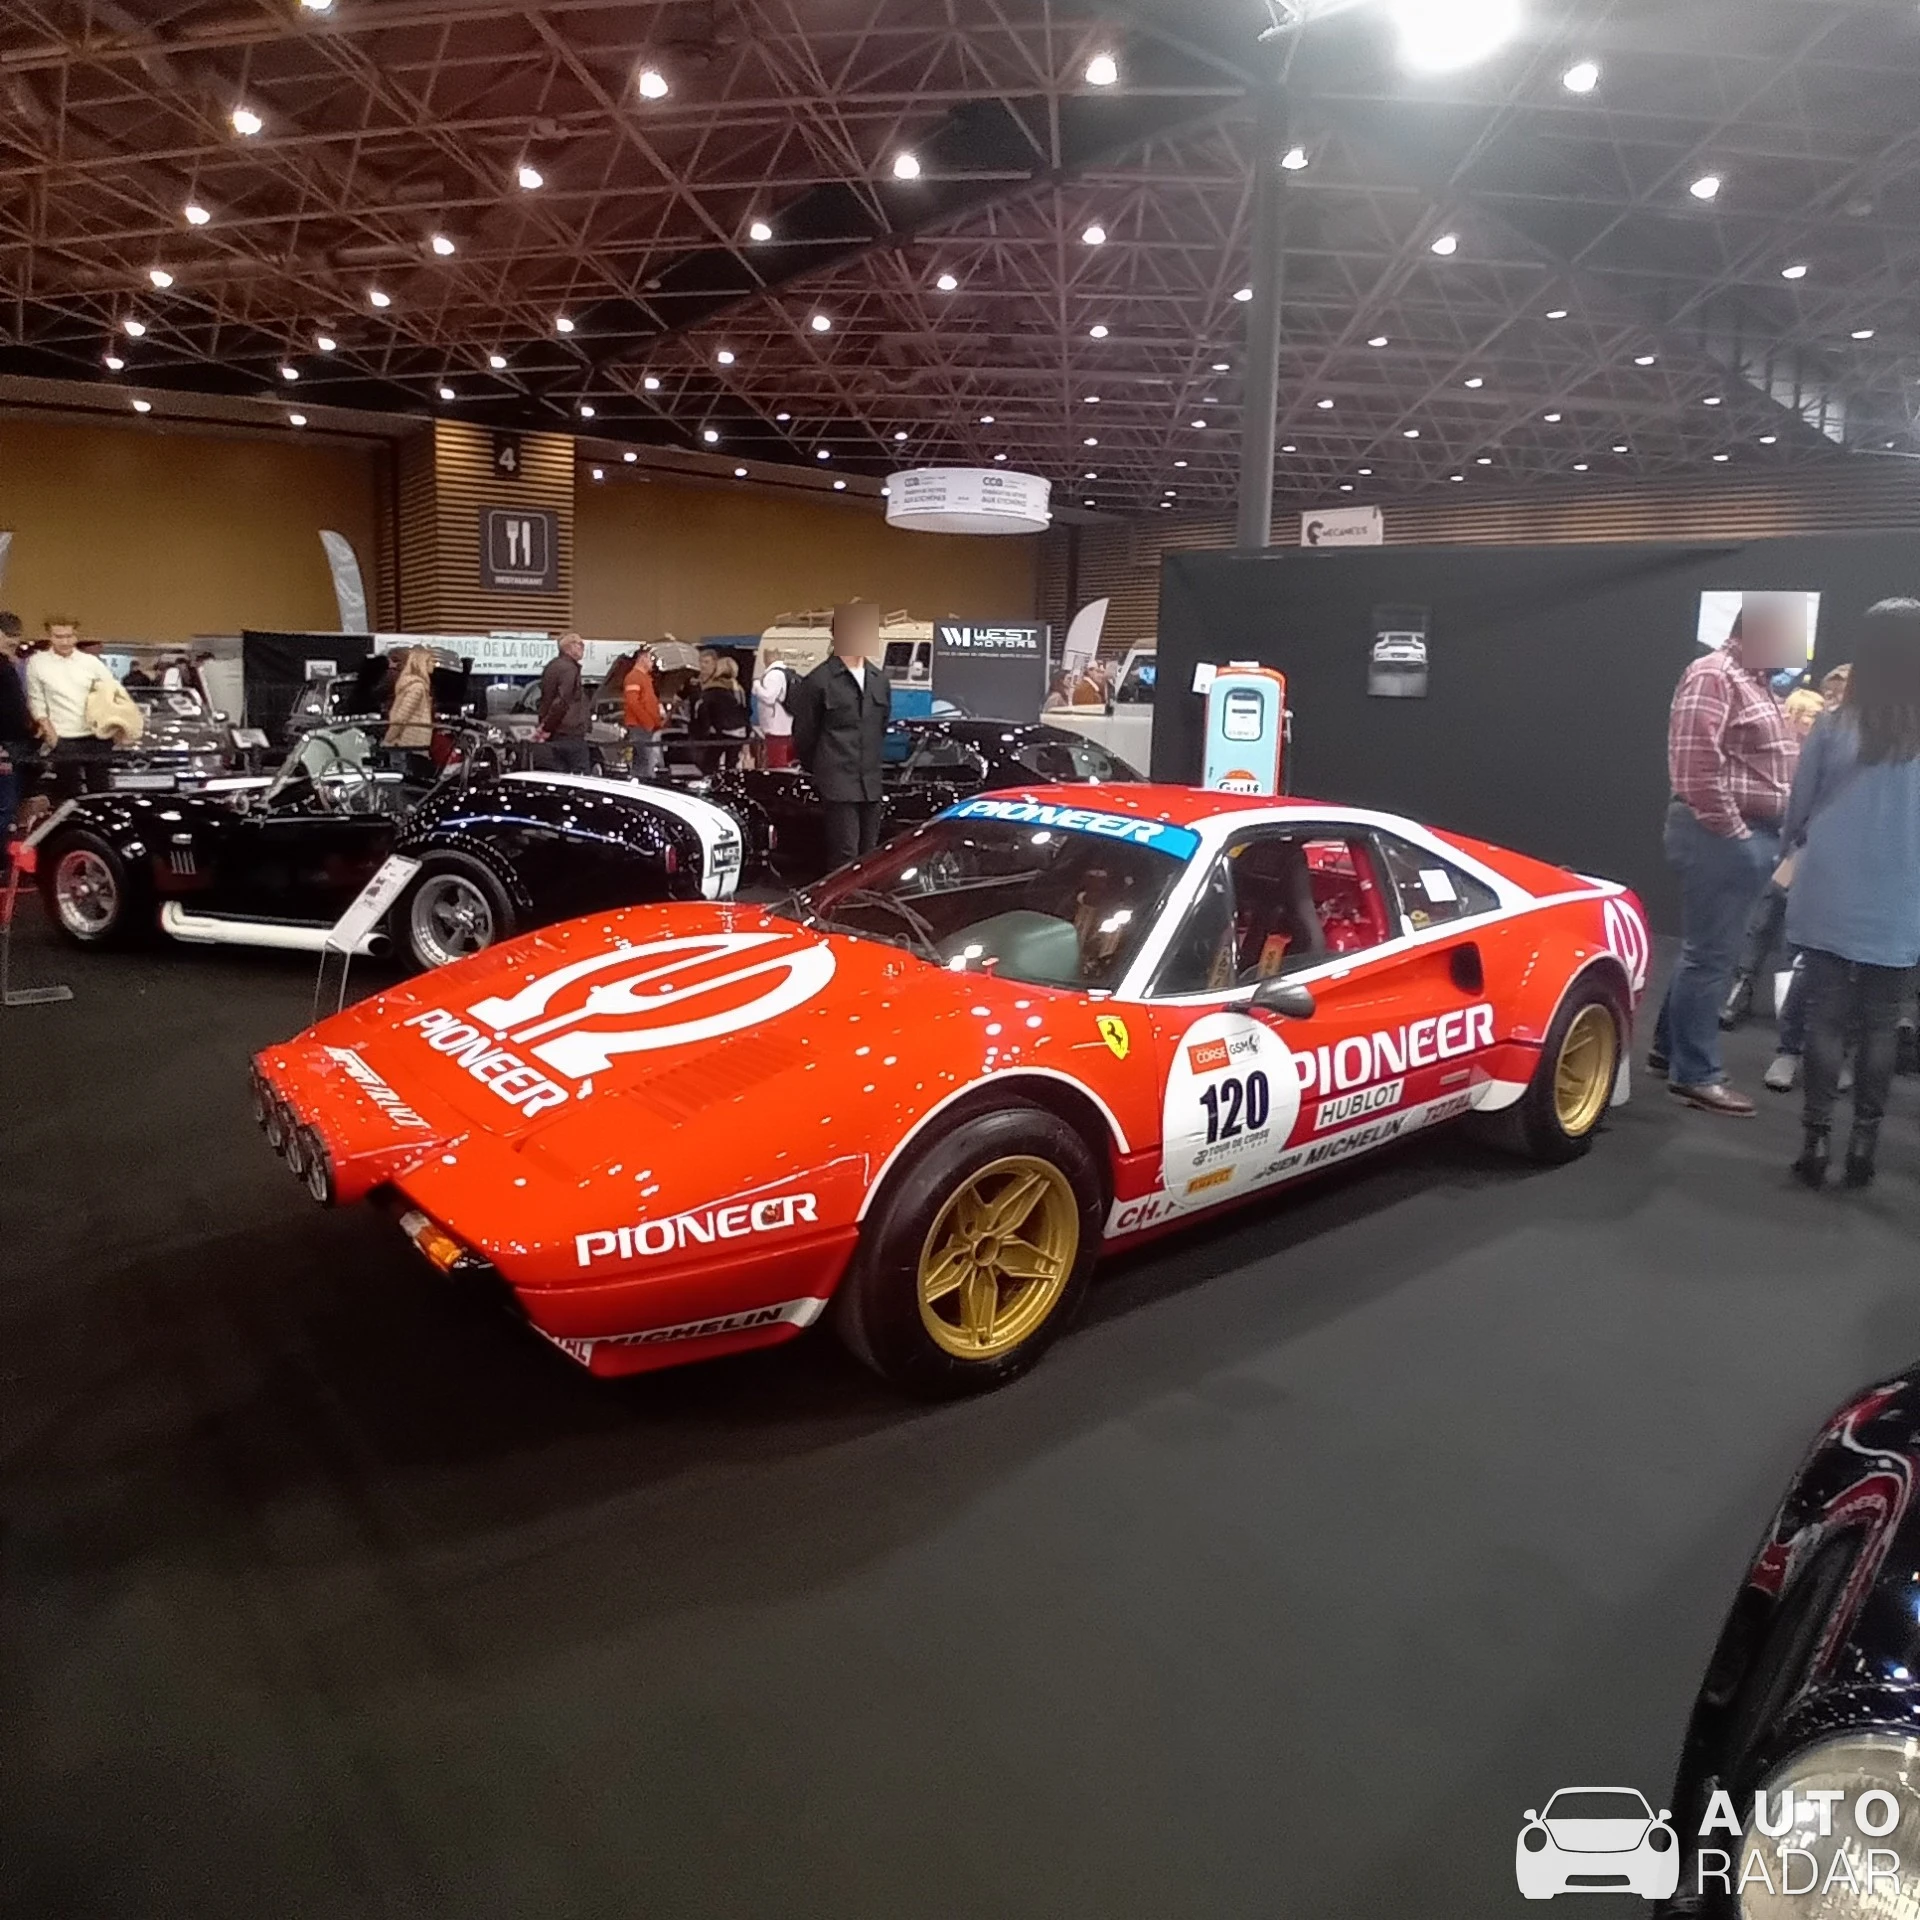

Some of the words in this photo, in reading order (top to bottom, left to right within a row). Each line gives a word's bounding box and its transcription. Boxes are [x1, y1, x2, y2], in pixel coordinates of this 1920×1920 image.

[499, 447, 516, 471] 4
[495, 576, 543, 586] RESTAURANT
[973, 628, 1037, 641] WEST
[973, 640, 1037, 648] MOTORS
[484, 641, 499, 657] DE
[503, 642, 517, 657] LA
[959, 800, 1165, 843] PIONEER
[1196, 1046, 1227, 1064] CORSE
[1229, 1040, 1249, 1054] GSM
[1292, 1003, 1496, 1096] PIONEER
[403, 1007, 569, 1117] PIONEER
[1199, 1070, 1269, 1145] 120
[1319, 1082, 1400, 1126] HUBLOT
[1208, 1141, 1230, 1156] TOUR
[1231, 1137, 1243, 1149] DE
[1244, 1128, 1270, 1144] CORSE
[1304, 1116, 1404, 1167] MICHELIN
[575, 1193, 819, 1266] PIONEER
